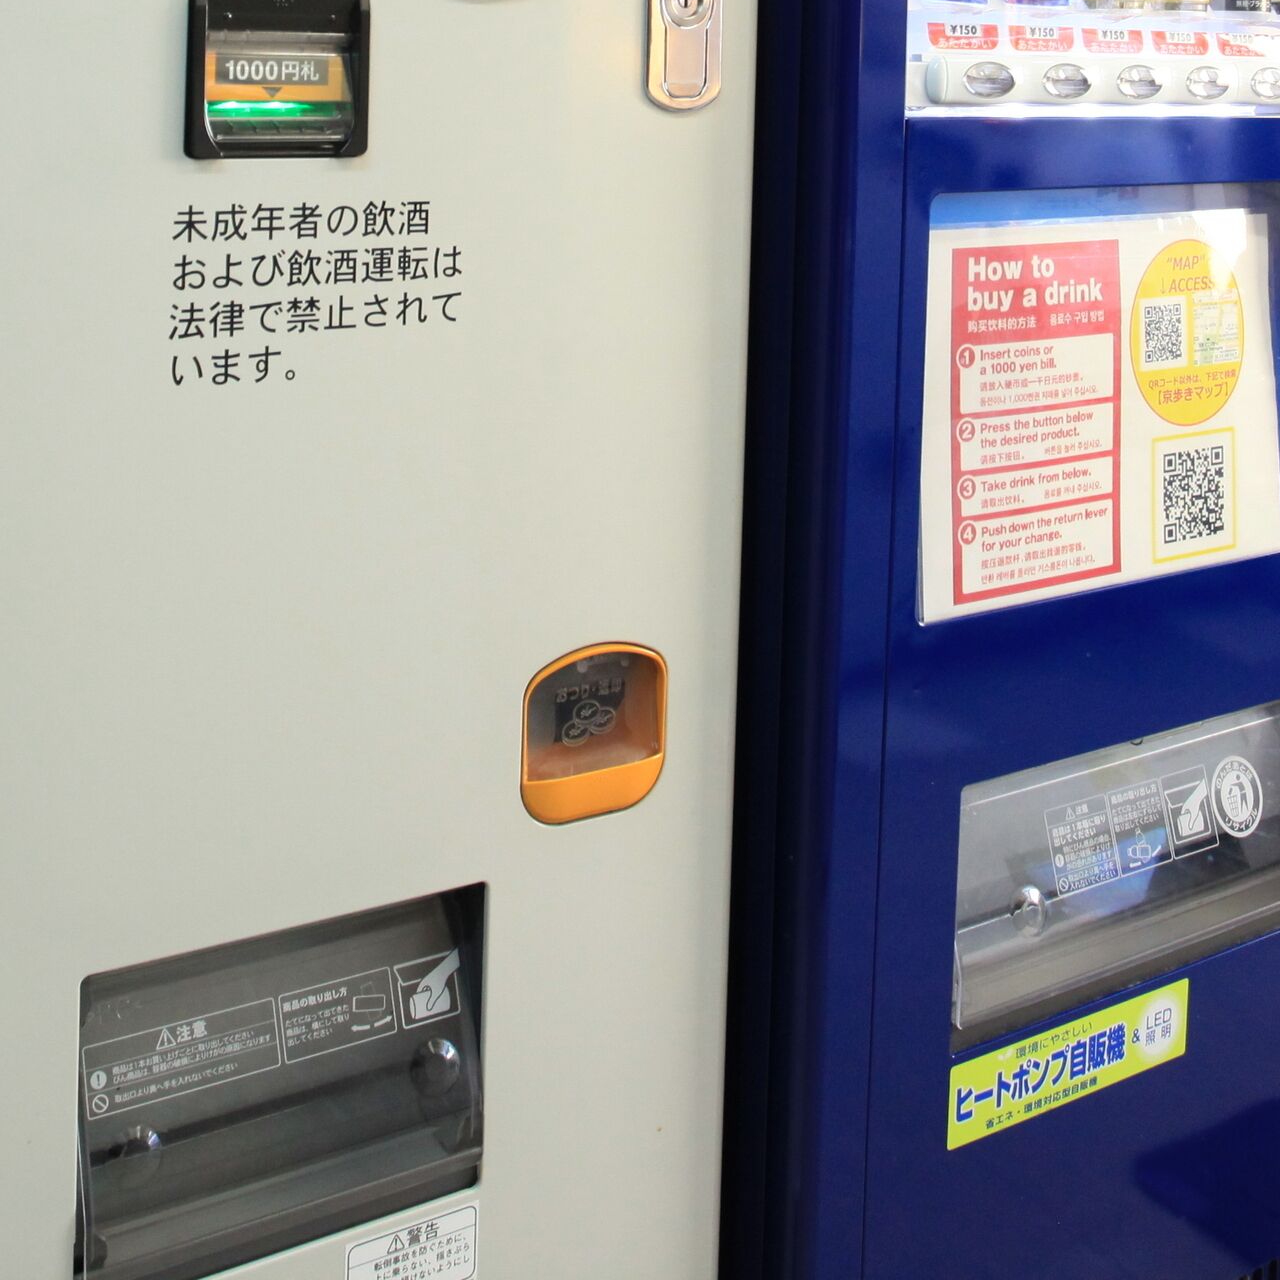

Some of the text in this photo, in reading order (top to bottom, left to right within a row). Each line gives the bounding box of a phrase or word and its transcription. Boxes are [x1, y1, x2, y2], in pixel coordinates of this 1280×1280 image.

[950, 25, 978, 36] ¥150
[1030, 27, 1055, 38] ¥150
[1102, 30, 1125, 40] ¥150
[1169, 32, 1192, 42] ¥150
[937, 37, 993, 49] あたたかい
[1017, 39, 1068, 51] あたたかい
[1090, 42, 1139, 53] あたたかい
[1160, 43, 1205, 54] あたたかい
[224, 59, 320, 82] 1000円札
[172, 200, 430, 243] 未成年者の飲酒
[172, 245, 462, 291] および飲酒運転は
[968, 255, 1055, 282] How to
[968, 277, 1103, 312] buy a drink
[169, 292, 462, 340] 法律で禁止されて
[968, 316, 1037, 333] 购买饮料的方法
[1074, 311, 1088, 324] 구입
[1090, 310, 1104, 322] 방법
[171, 345, 296, 386] います。
[980, 346, 1054, 362] Insert coins or
[980, 358, 1056, 375] a 1000 yen bill.
[980, 411, 1093, 434] Press the button below
[980, 427, 1080, 449] the desired product.
[981, 467, 1091, 492] Take drink from below.
[981, 507, 1108, 538] Push down the return lever
[981, 529, 1063, 553] for your change.
[1216, 760, 1253, 789] のんだあとは
[1225, 807, 1258, 831] リサイクル
[1146, 1007, 1172, 1030] LED
[176, 1020, 208, 1044] 注意
[1015, 1021, 1093, 1059] 環境にやさしい
[1145, 1023, 1172, 1047] 照明
[955, 1022, 1140, 1123] ヒートポンプ自販機 &
[985, 1076, 1098, 1130] 省エネ・環境対応型自販機
[406, 1221, 440, 1248] 警告
